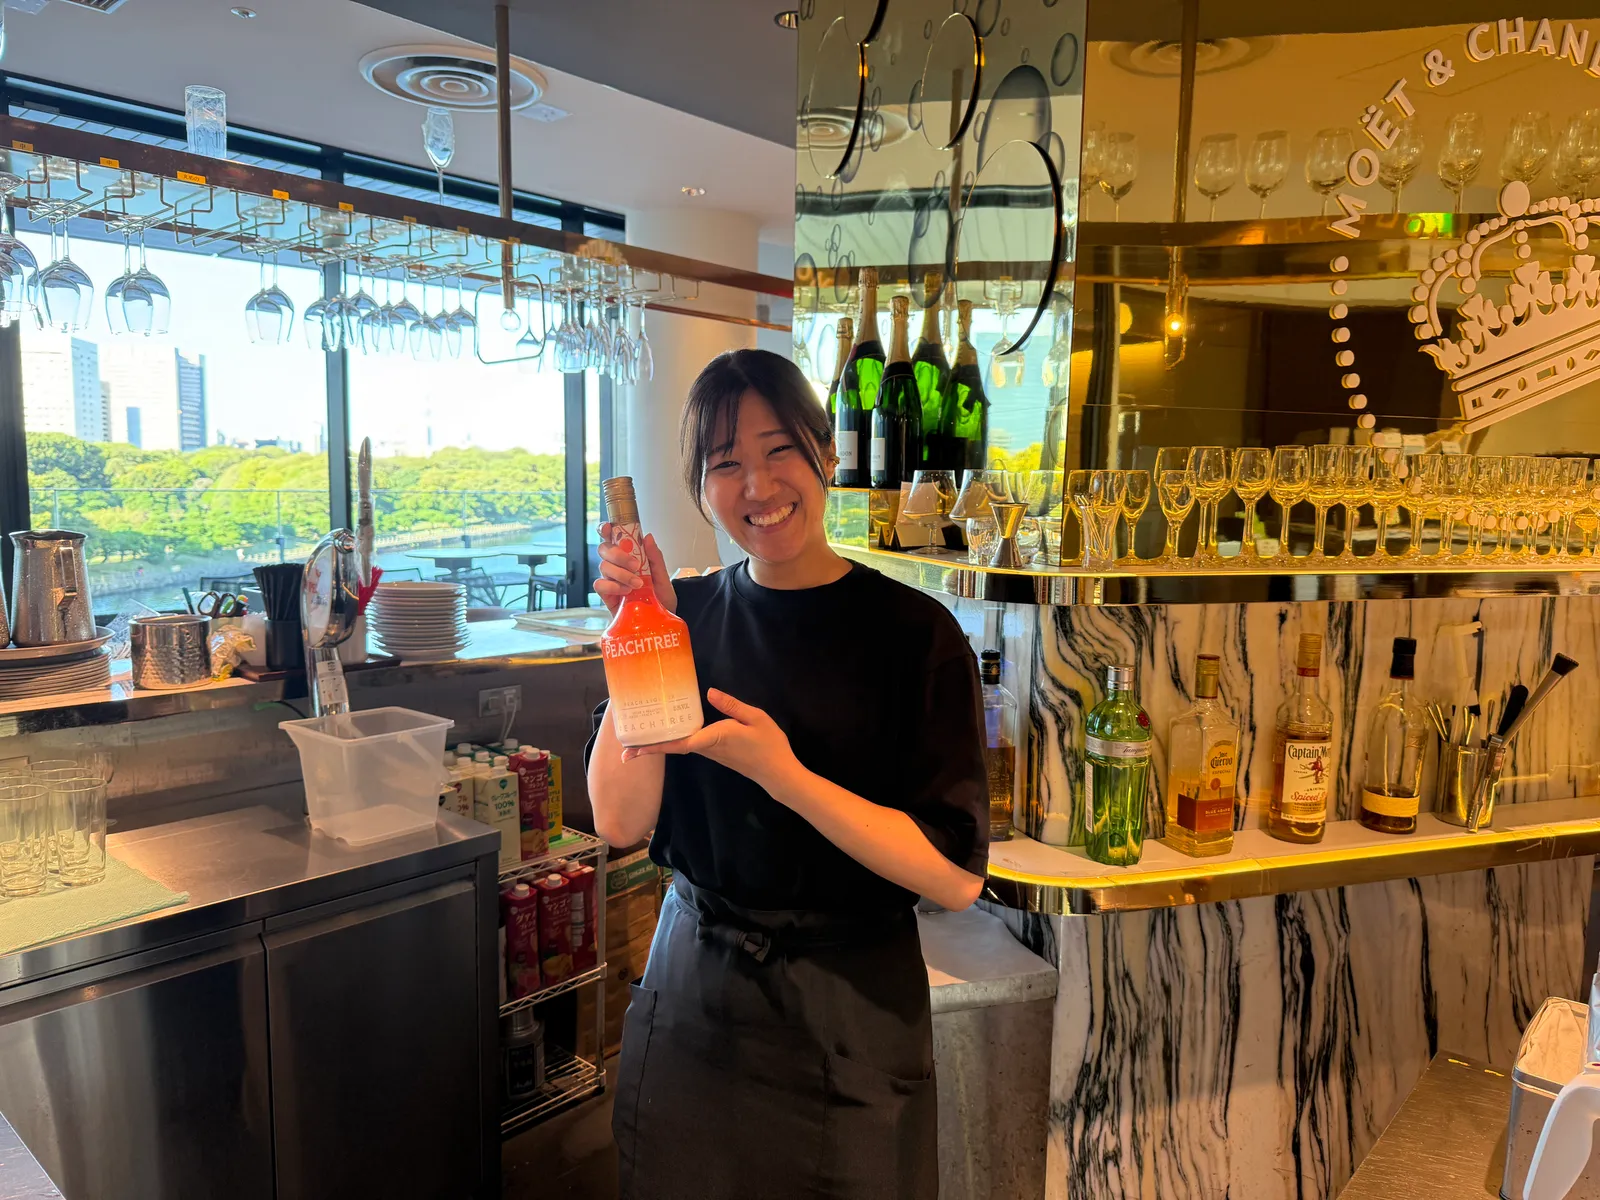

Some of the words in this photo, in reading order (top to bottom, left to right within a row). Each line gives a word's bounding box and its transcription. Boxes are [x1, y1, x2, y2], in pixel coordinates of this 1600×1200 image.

[1328, 78, 1415, 238] MOËT
[1424, 49, 1455, 87] &
[605, 633, 680, 659] PEACHTREE
[1288, 745, 1319, 760] Captain
[1210, 756, 1233, 769] Cuervo
[1291, 791, 1319, 801] Spiced
[495, 800, 515, 810] 100%
